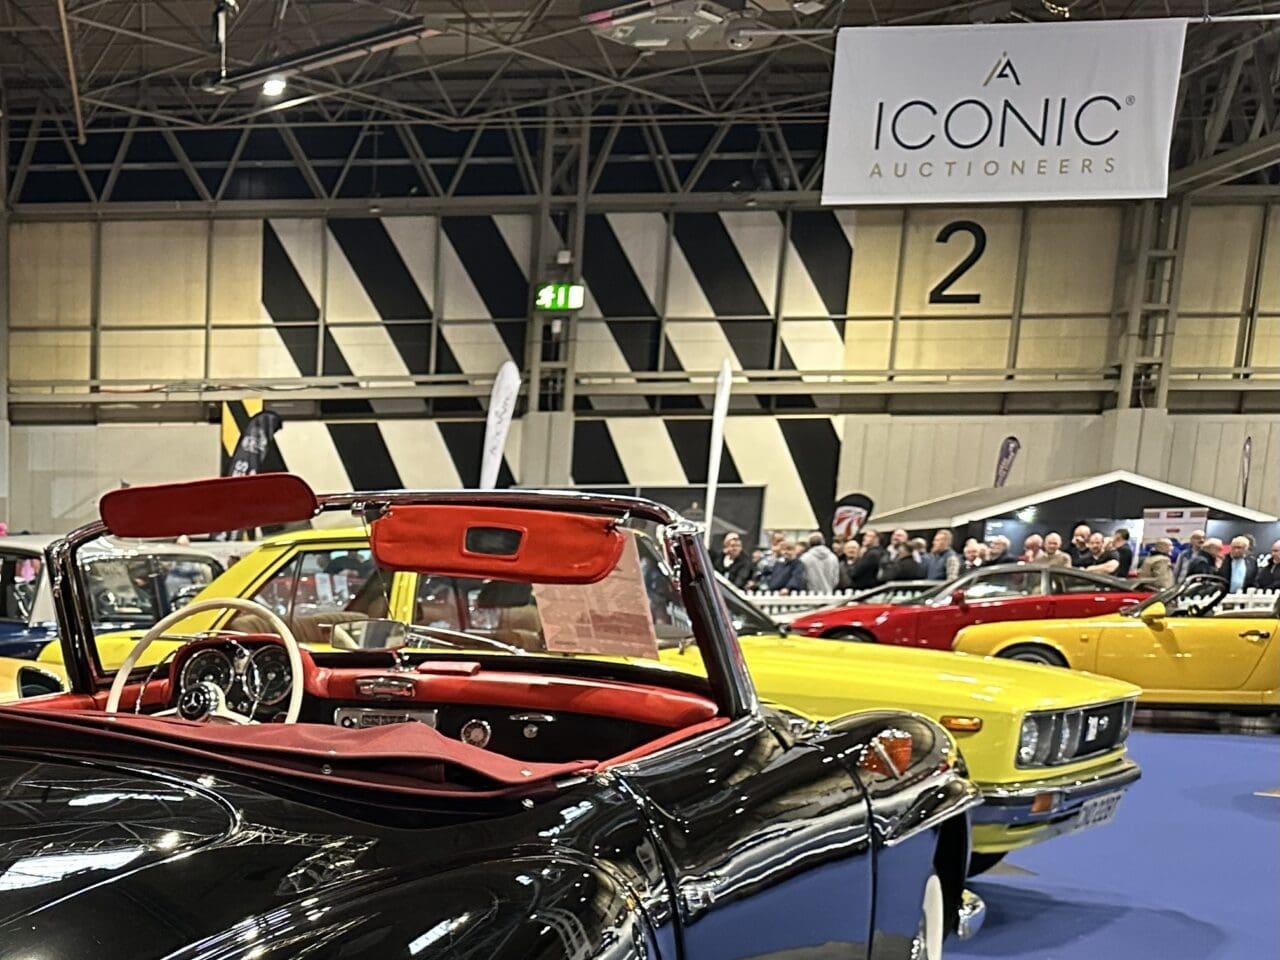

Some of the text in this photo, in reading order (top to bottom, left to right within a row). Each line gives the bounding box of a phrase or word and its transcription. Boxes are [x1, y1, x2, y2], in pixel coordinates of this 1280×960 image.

[874, 95, 1122, 150] ICONIC
[870, 157, 1116, 178] AUCTIONEERS
[928, 220, 988, 304] 2
